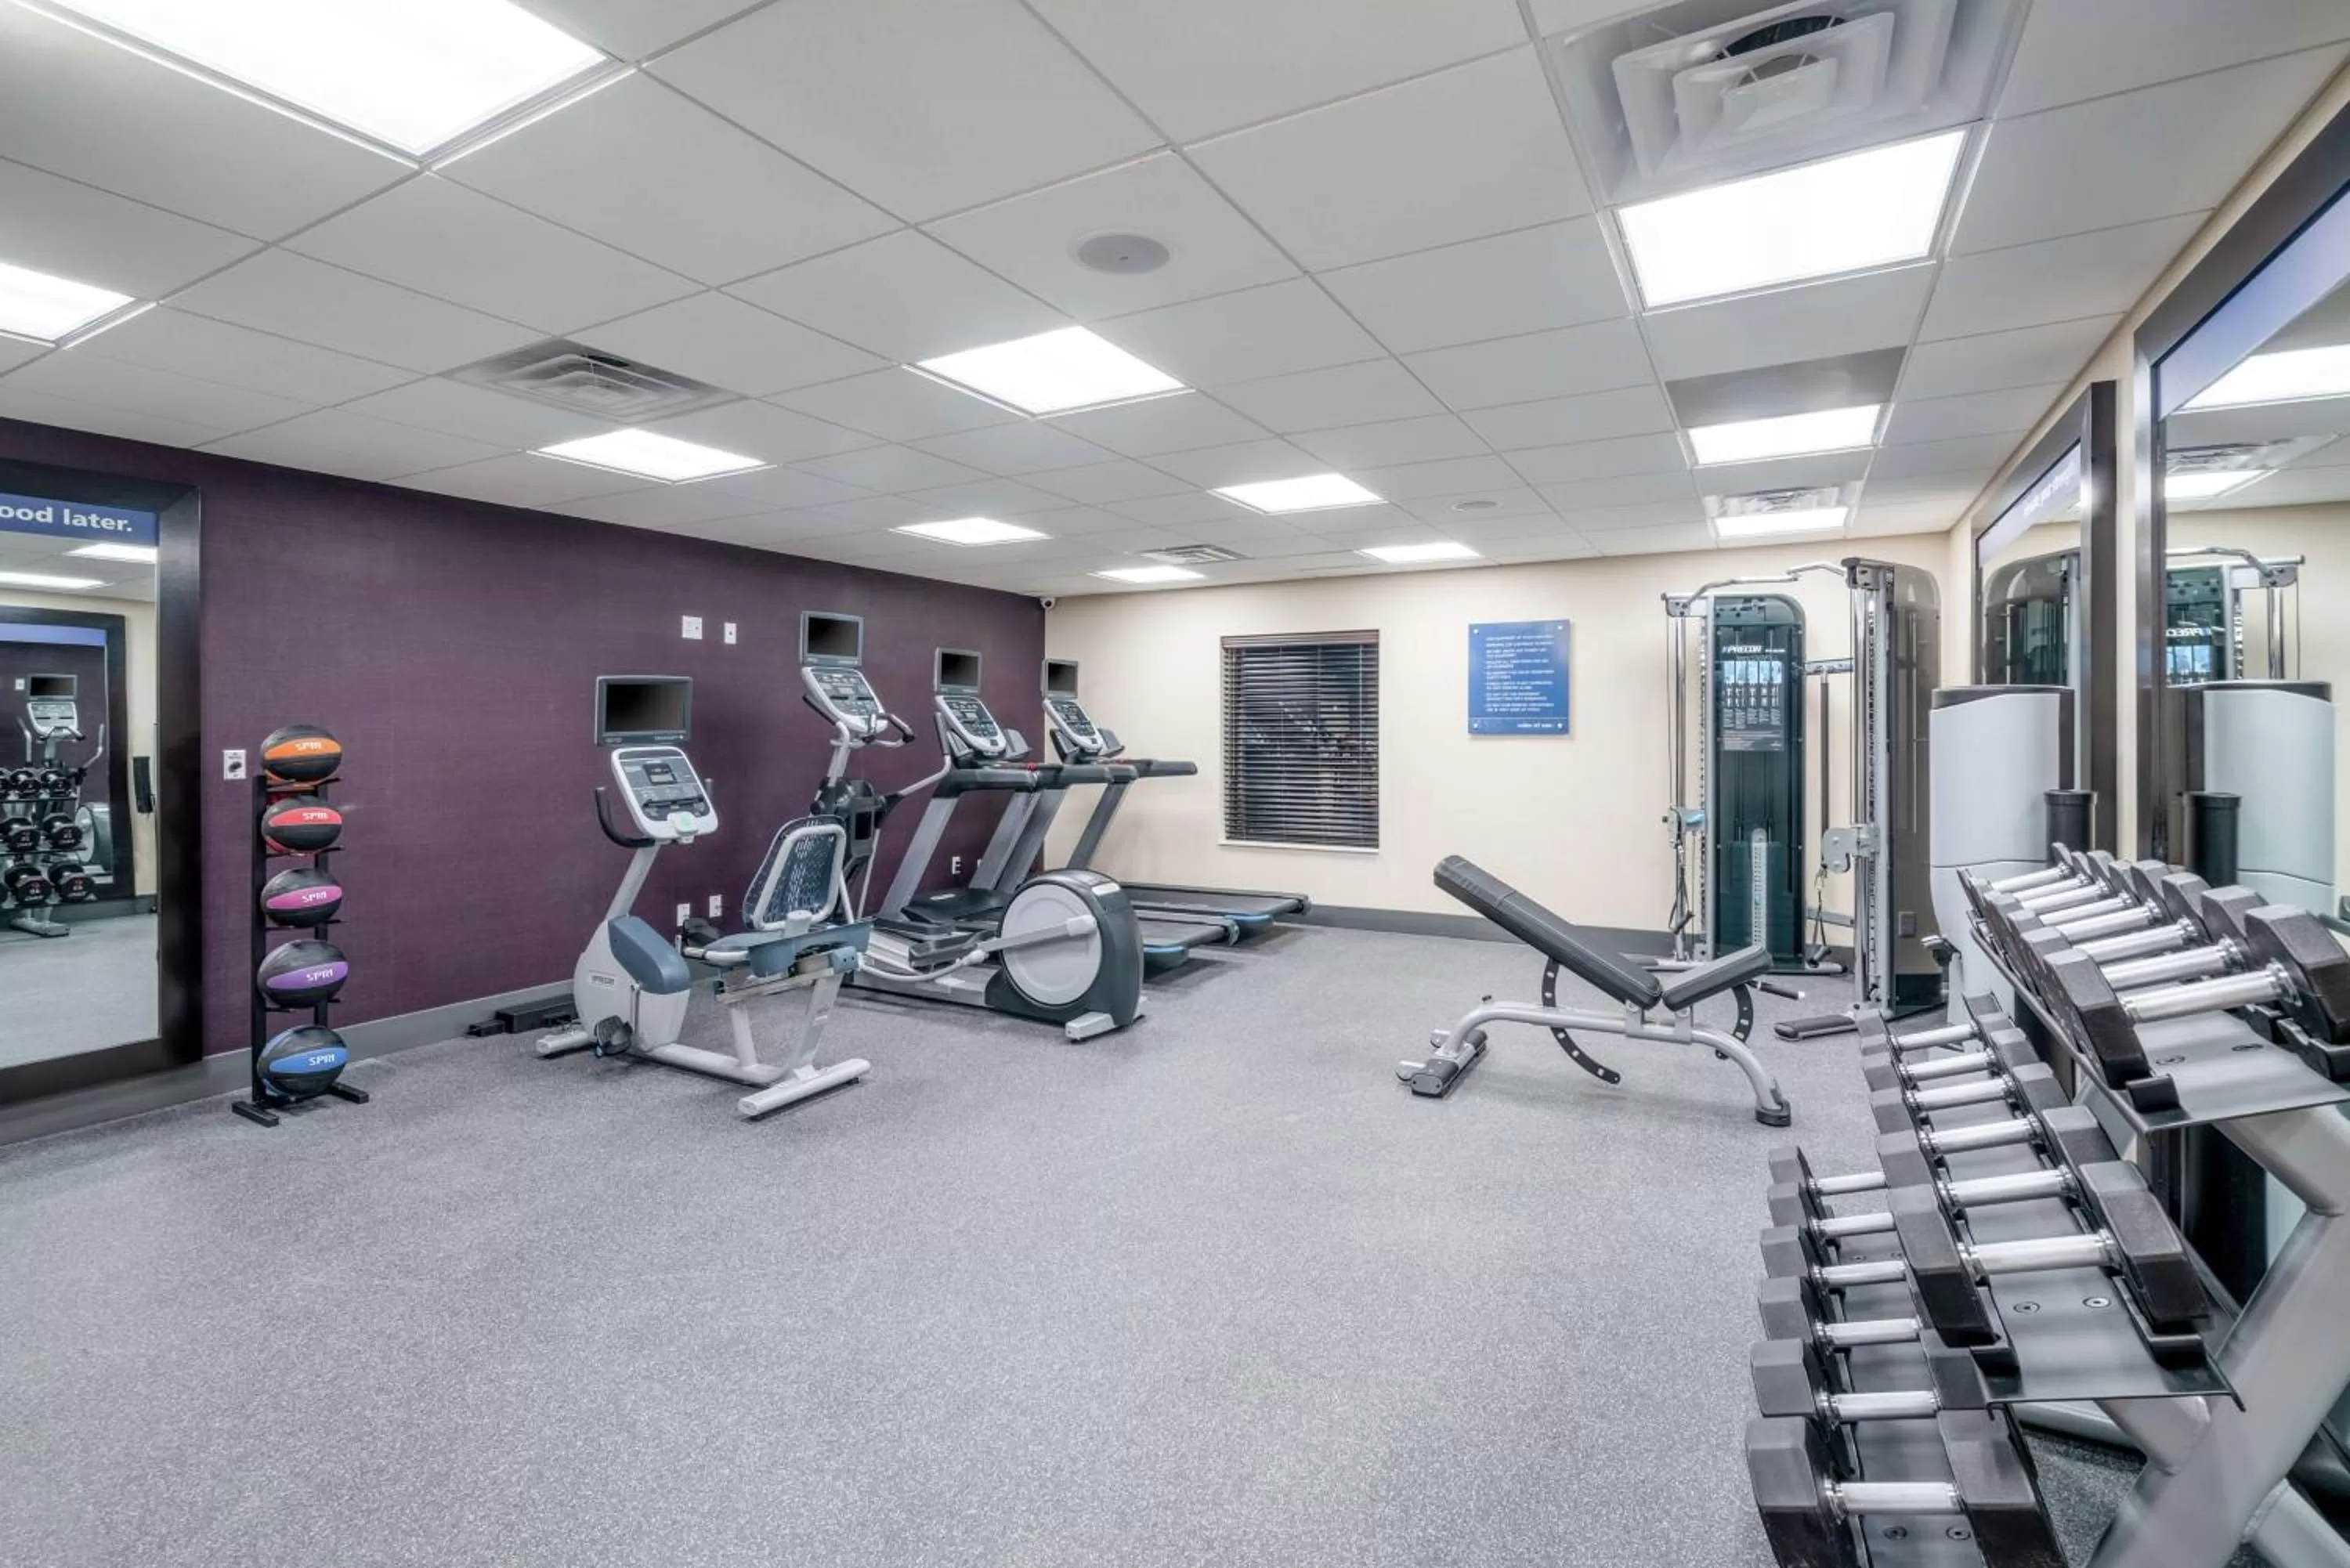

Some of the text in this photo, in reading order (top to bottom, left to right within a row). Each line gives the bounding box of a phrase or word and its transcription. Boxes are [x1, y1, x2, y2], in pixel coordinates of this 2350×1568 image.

[63, 508, 133, 532] later.
[306, 968, 333, 981] SPRI
[309, 1053, 335, 1066] SPRI
